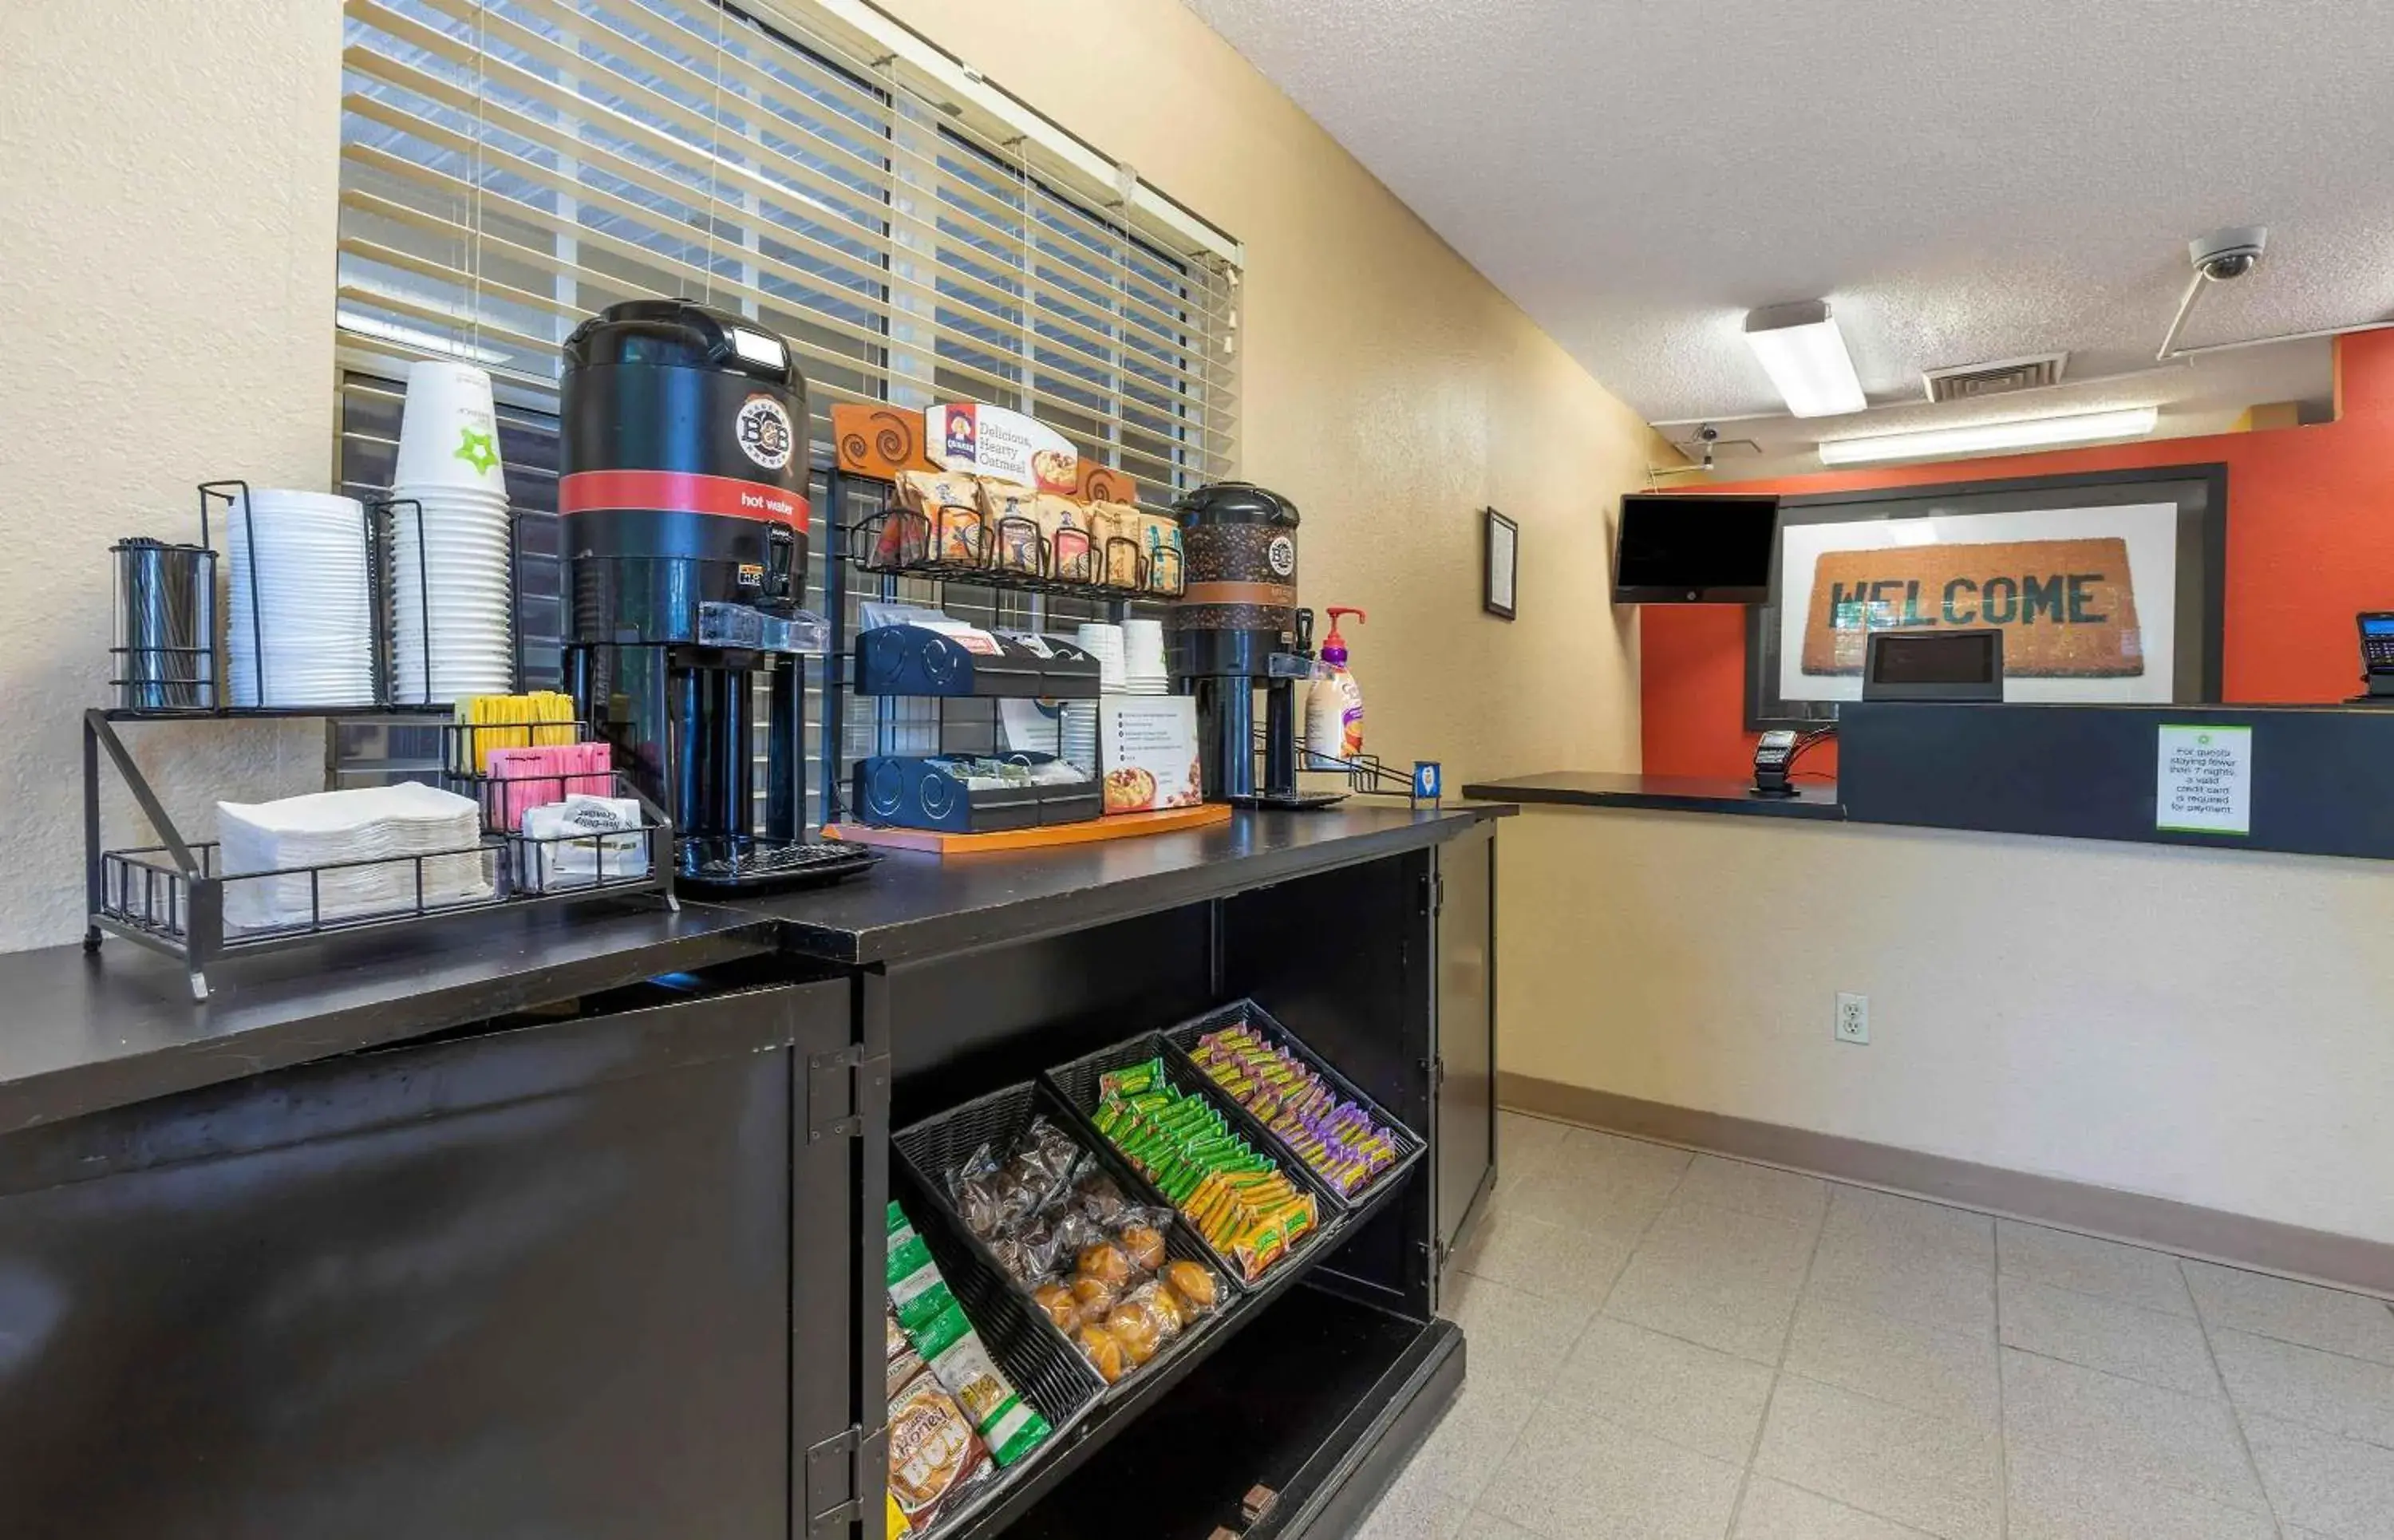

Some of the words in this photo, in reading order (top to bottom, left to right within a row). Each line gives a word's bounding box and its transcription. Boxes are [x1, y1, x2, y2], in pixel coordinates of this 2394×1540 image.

[980, 436, 1018, 460] Hearty
[979, 452, 1026, 474] Oatmeal
[741, 492, 764, 508] hot
[766, 498, 794, 515] water
[1828, 574, 2108, 629] WELCOME
[2171, 757, 2206, 766] staying
[895, 1406, 950, 1457] Honey
[901, 1419, 967, 1489] BUN
